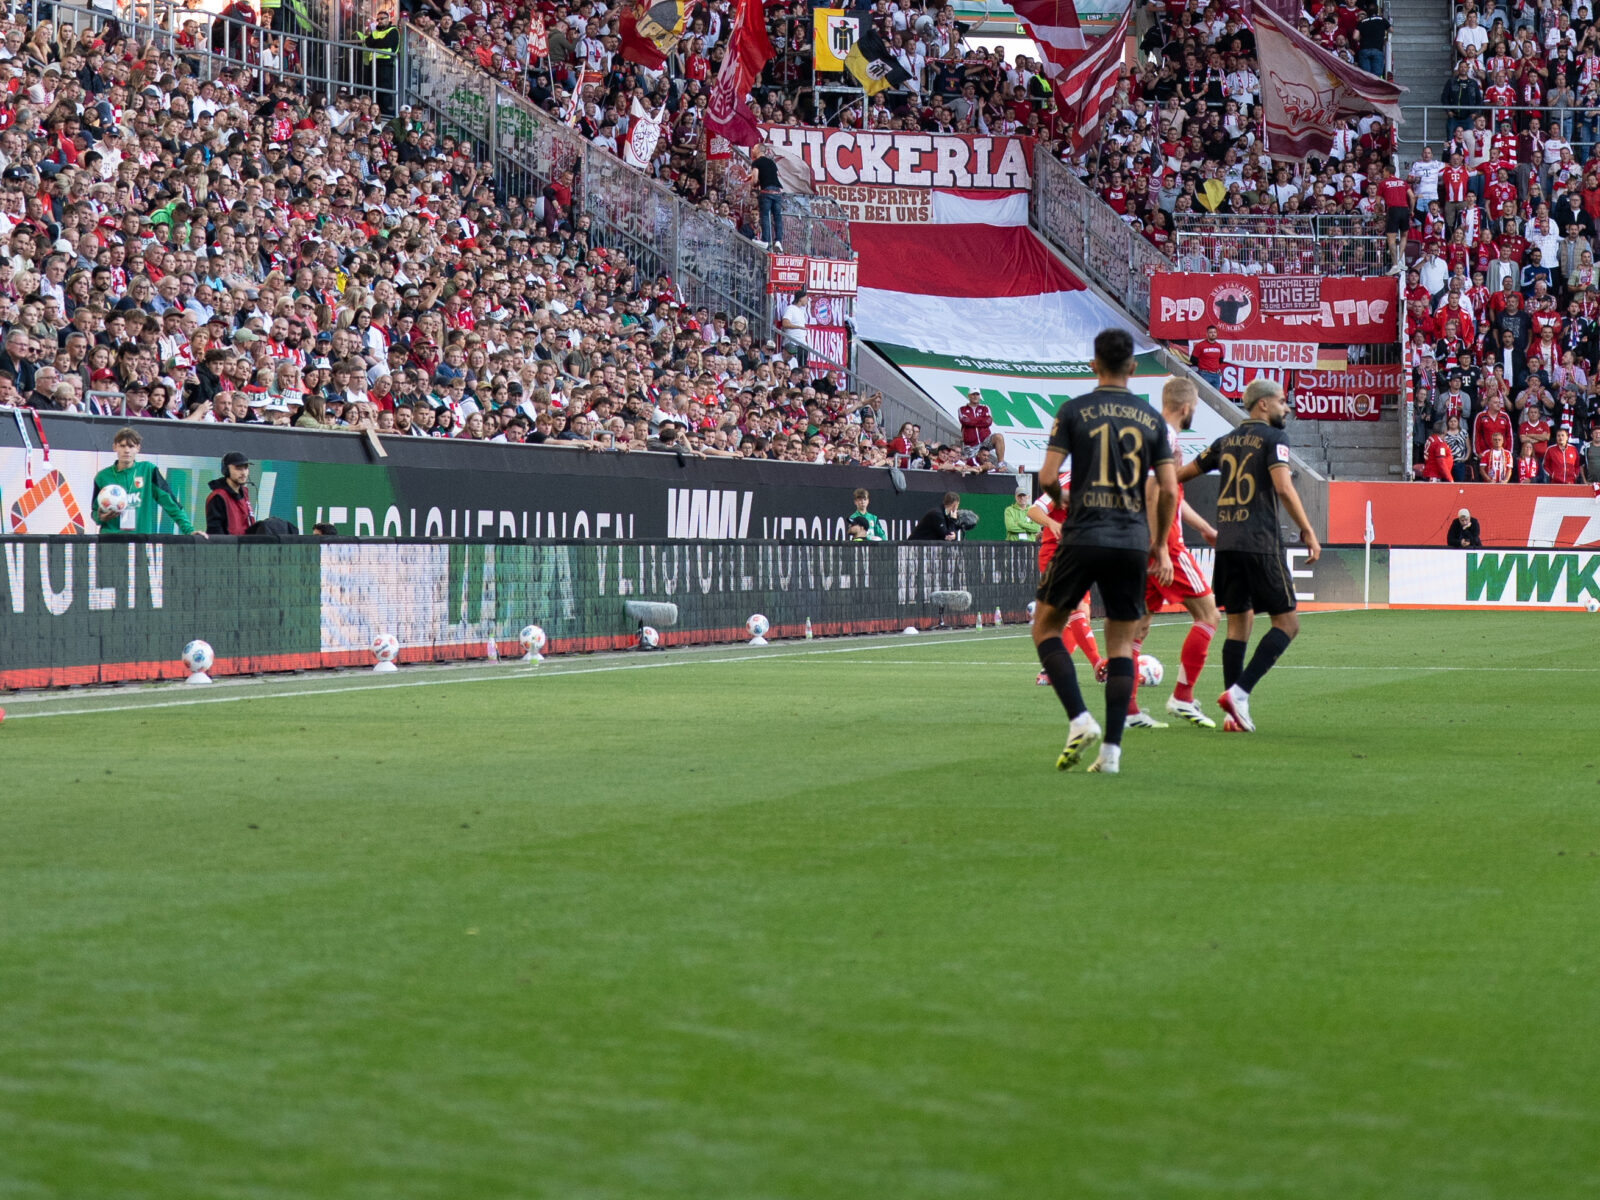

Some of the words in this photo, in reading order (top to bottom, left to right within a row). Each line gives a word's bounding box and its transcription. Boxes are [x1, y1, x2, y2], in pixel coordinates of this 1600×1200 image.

[757, 126, 1028, 189] HICKERIA
[819, 185, 931, 206] USGESPERRTE
[864, 205, 891, 221] BEI
[896, 206, 929, 222] UNS
[1260, 279, 1320, 289] DURCHHALTEN
[1261, 287, 1320, 303] JUNGS!
[1161, 296, 1205, 322] RED
[973, 359, 1013, 371] JAHRE
[1080, 406, 1097, 422] FC
[1098, 403, 1159, 430] AUGSBURG
[1089, 422, 1143, 489] 13
[1217, 453, 1255, 506] 26
[1218, 509, 1250, 523] SAAD
[1466, 552, 1600, 603] WWK
